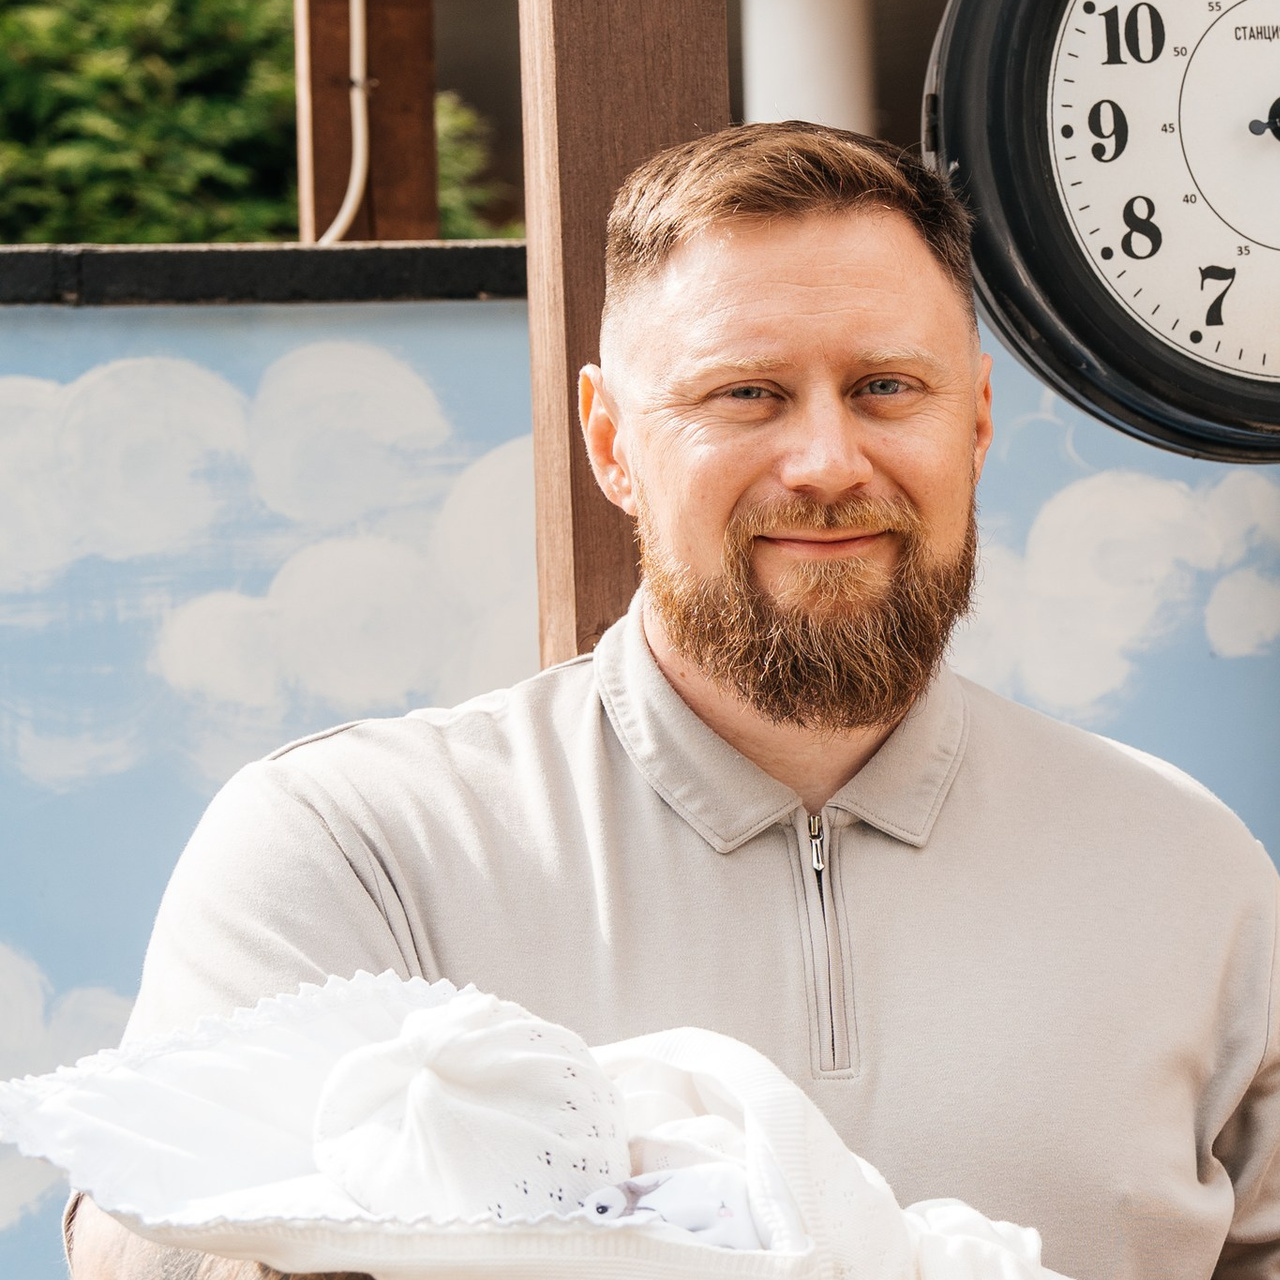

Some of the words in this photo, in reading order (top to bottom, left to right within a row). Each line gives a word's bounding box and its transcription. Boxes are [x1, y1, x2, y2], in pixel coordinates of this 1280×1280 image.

[1207, 1, 1223, 13] 55
[1098, 2, 1166, 66] 10
[1173, 46, 1188, 57] 50
[1087, 99, 1129, 164] 9
[1160, 122, 1176, 134] 45
[1182, 193, 1197, 204] 40
[1120, 195, 1163, 260] 8
[1237, 245, 1251, 257] 35
[1198, 264, 1237, 327] 7
